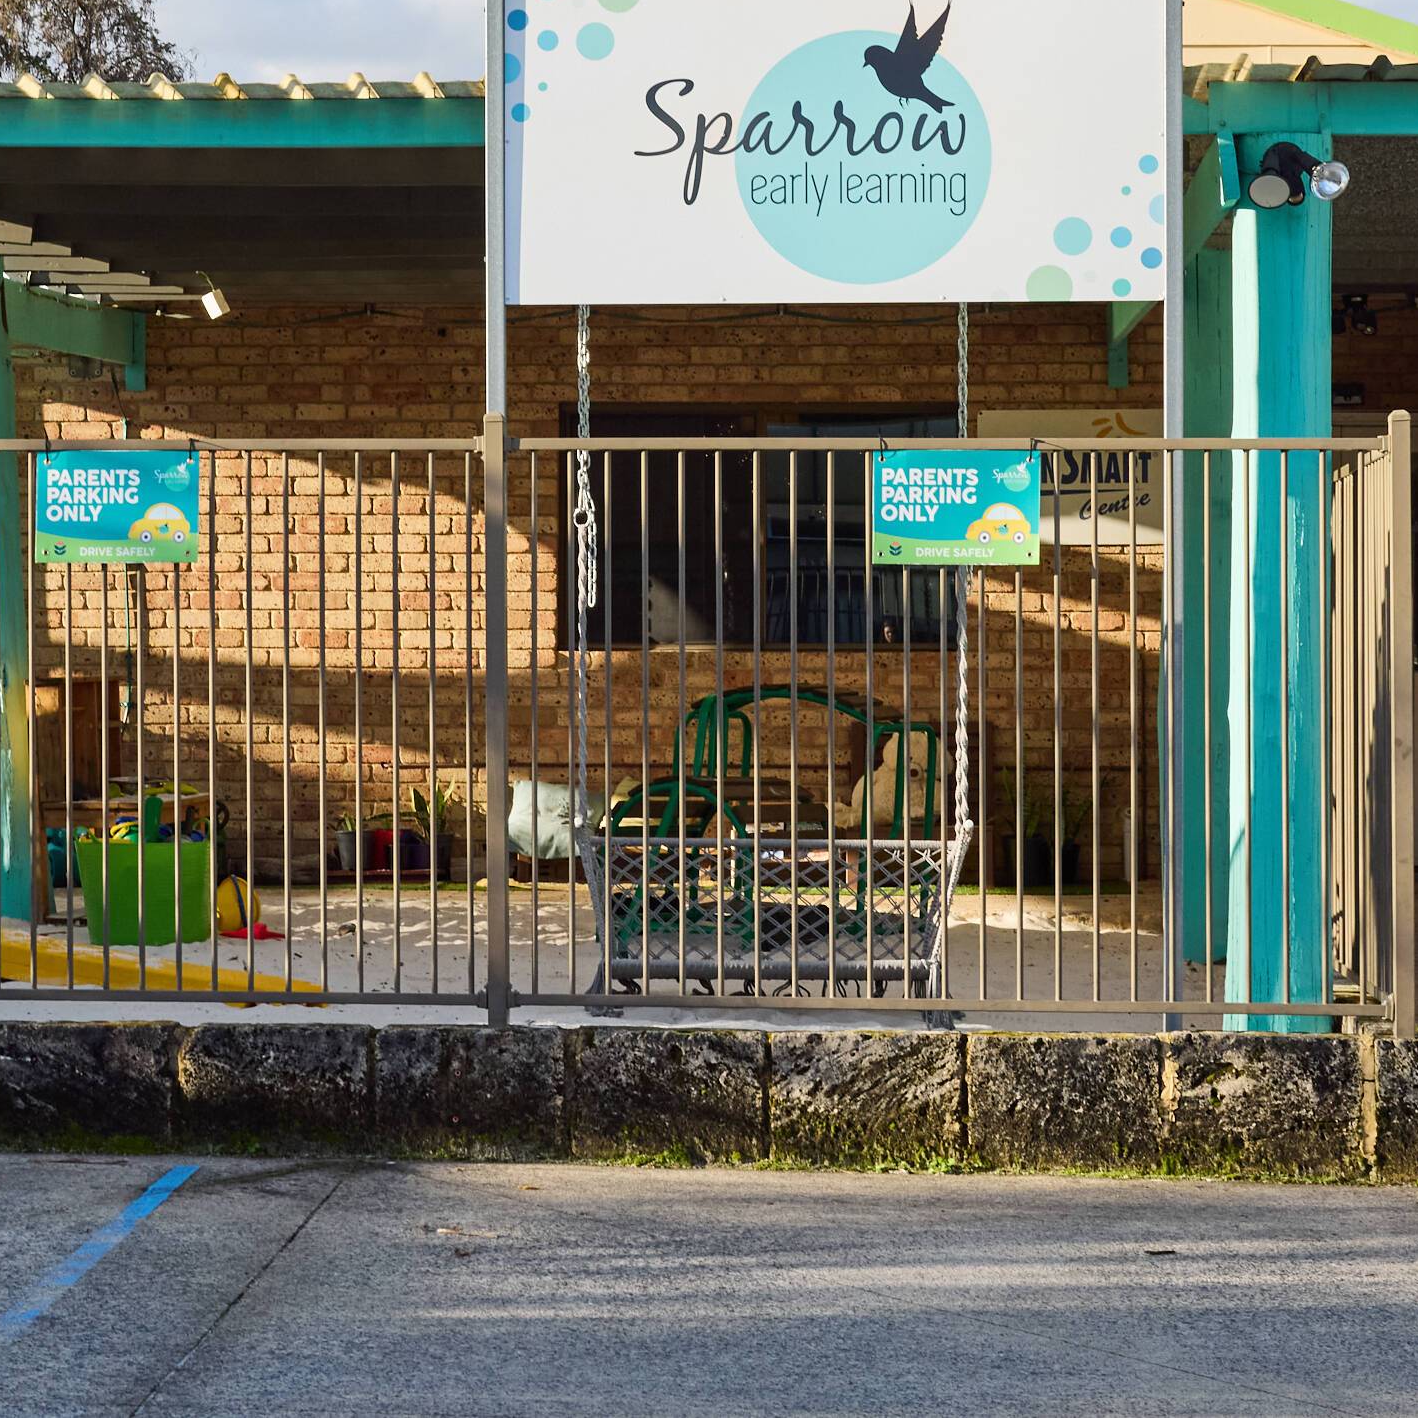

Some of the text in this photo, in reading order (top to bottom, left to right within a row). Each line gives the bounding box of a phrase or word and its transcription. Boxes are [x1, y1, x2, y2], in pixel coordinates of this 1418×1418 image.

[634, 78, 966, 205] Sparrow
[751, 162, 967, 217] early learning
[47, 469, 140, 486] PARENTS
[882, 468, 979, 486] PARENTS
[47, 487, 139, 504] PARKING
[882, 486, 977, 504] PARKING
[46, 505, 103, 522] ONLY
[881, 504, 939, 522] ONLY
[80, 547, 155, 556] DRIVE SAFELY
[915, 547, 995, 558] DRIVE SAFELY
